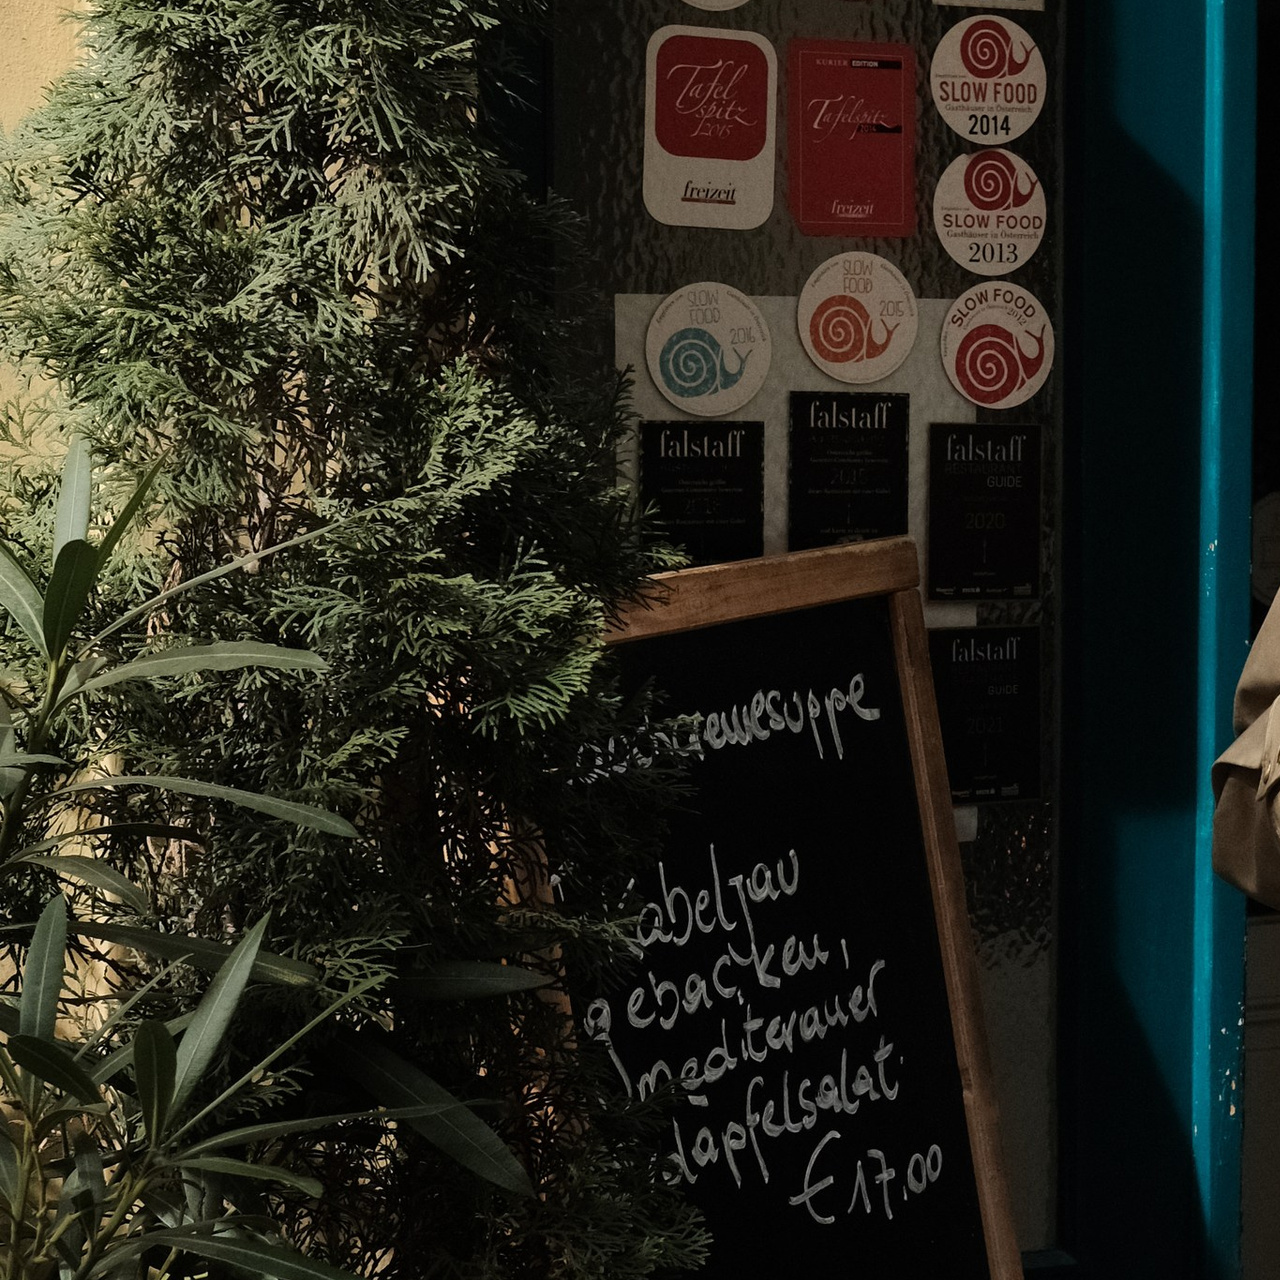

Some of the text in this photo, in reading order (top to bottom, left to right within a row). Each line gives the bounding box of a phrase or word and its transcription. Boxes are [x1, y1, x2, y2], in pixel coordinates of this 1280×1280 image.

[851, 60, 879, 68] EDITION
[667, 58, 749, 114] Tafel
[939, 80, 1038, 105] SLOW FOOD
[691, 99, 758, 138] spitz
[968, 113, 1011, 136] 2014
[683, 179, 738, 200] freizeit
[943, 213, 1043, 230] SLOW FOOD
[969, 242, 1018, 264] 2013
[843, 259, 873, 276] SLOW
[843, 277, 873, 294] FOOD
[687, 289, 719, 308] SLOW
[879, 300, 905, 317] 2015
[951, 289, 989, 328] SLOW
[993, 288, 1036, 319] FOOD
[689, 307, 721, 325] FOOD
[809, 399, 892, 430] falstaff
[659, 429, 746, 458] falstaff
[946, 432, 1027, 462] falstaff
[986, 475, 1023, 489] GUIDE
[952, 636, 1021, 663] falstaff
[987, 684, 1020, 697] GUIDE
